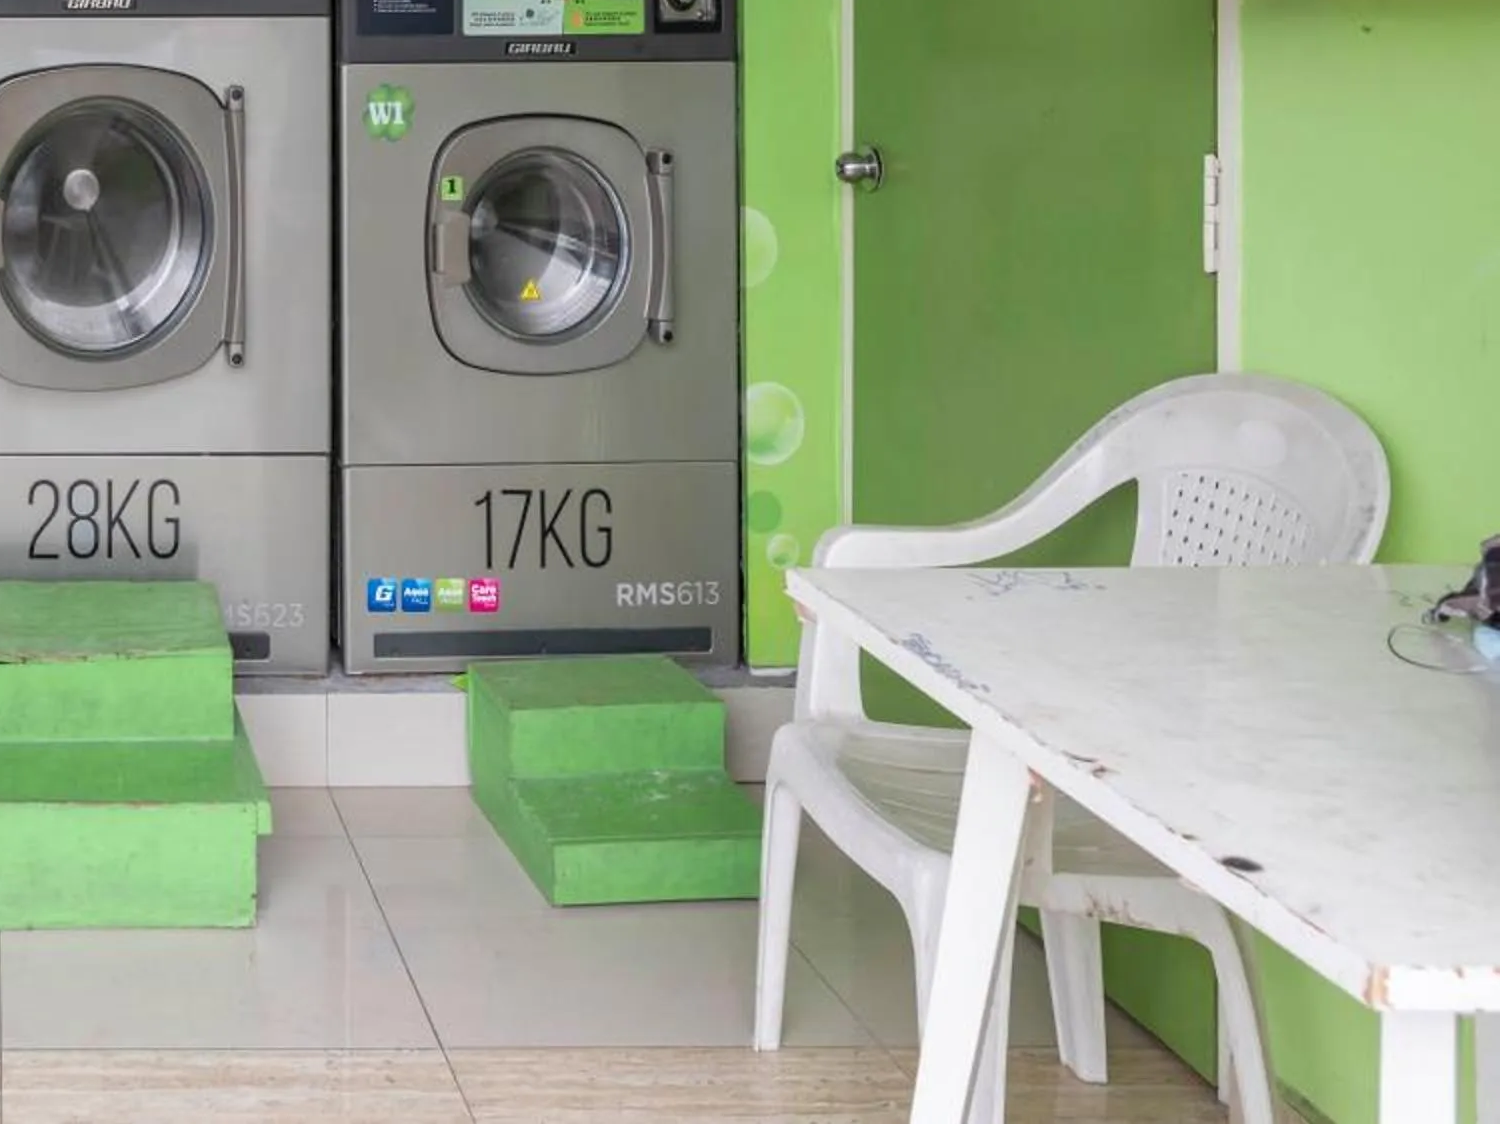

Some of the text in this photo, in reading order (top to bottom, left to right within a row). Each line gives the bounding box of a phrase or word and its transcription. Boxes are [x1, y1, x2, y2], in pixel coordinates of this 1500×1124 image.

[368, 101, 404, 124] W1
[447, 179, 457, 194] 1
[28, 479, 180, 559] 28KG
[474, 488, 612, 569] 17KG
[616, 581, 720, 607] RMS613
